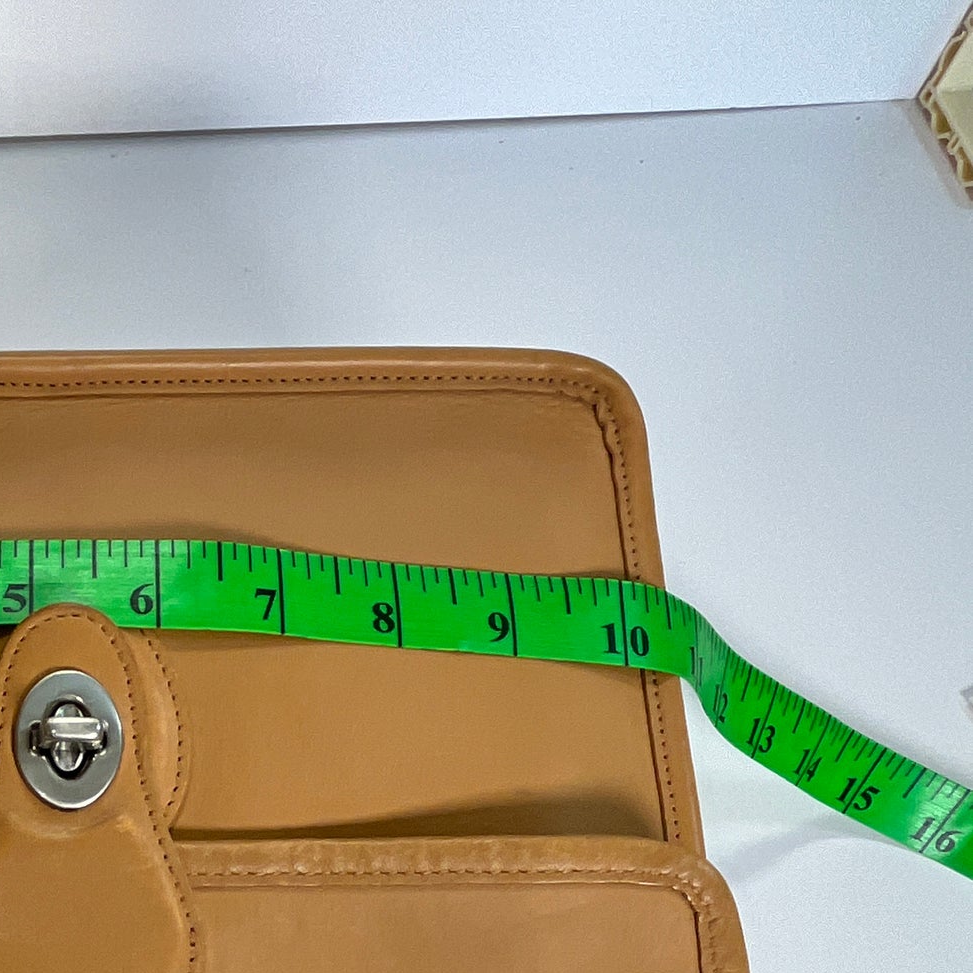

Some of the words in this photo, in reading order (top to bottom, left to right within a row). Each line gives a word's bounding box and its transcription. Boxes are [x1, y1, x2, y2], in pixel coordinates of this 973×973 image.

[2, 583, 27, 614] 5
[129, 583, 154, 615] 6
[254, 588, 277, 620] 7
[371, 602, 395, 633] 8
[488, 612, 511, 642] 9
[601, 623, 650, 657] 10
[746, 718, 776, 753] 13
[793, 749, 823, 782] 14
[835, 778, 881, 811] 15
[909, 817, 964, 853] 16
